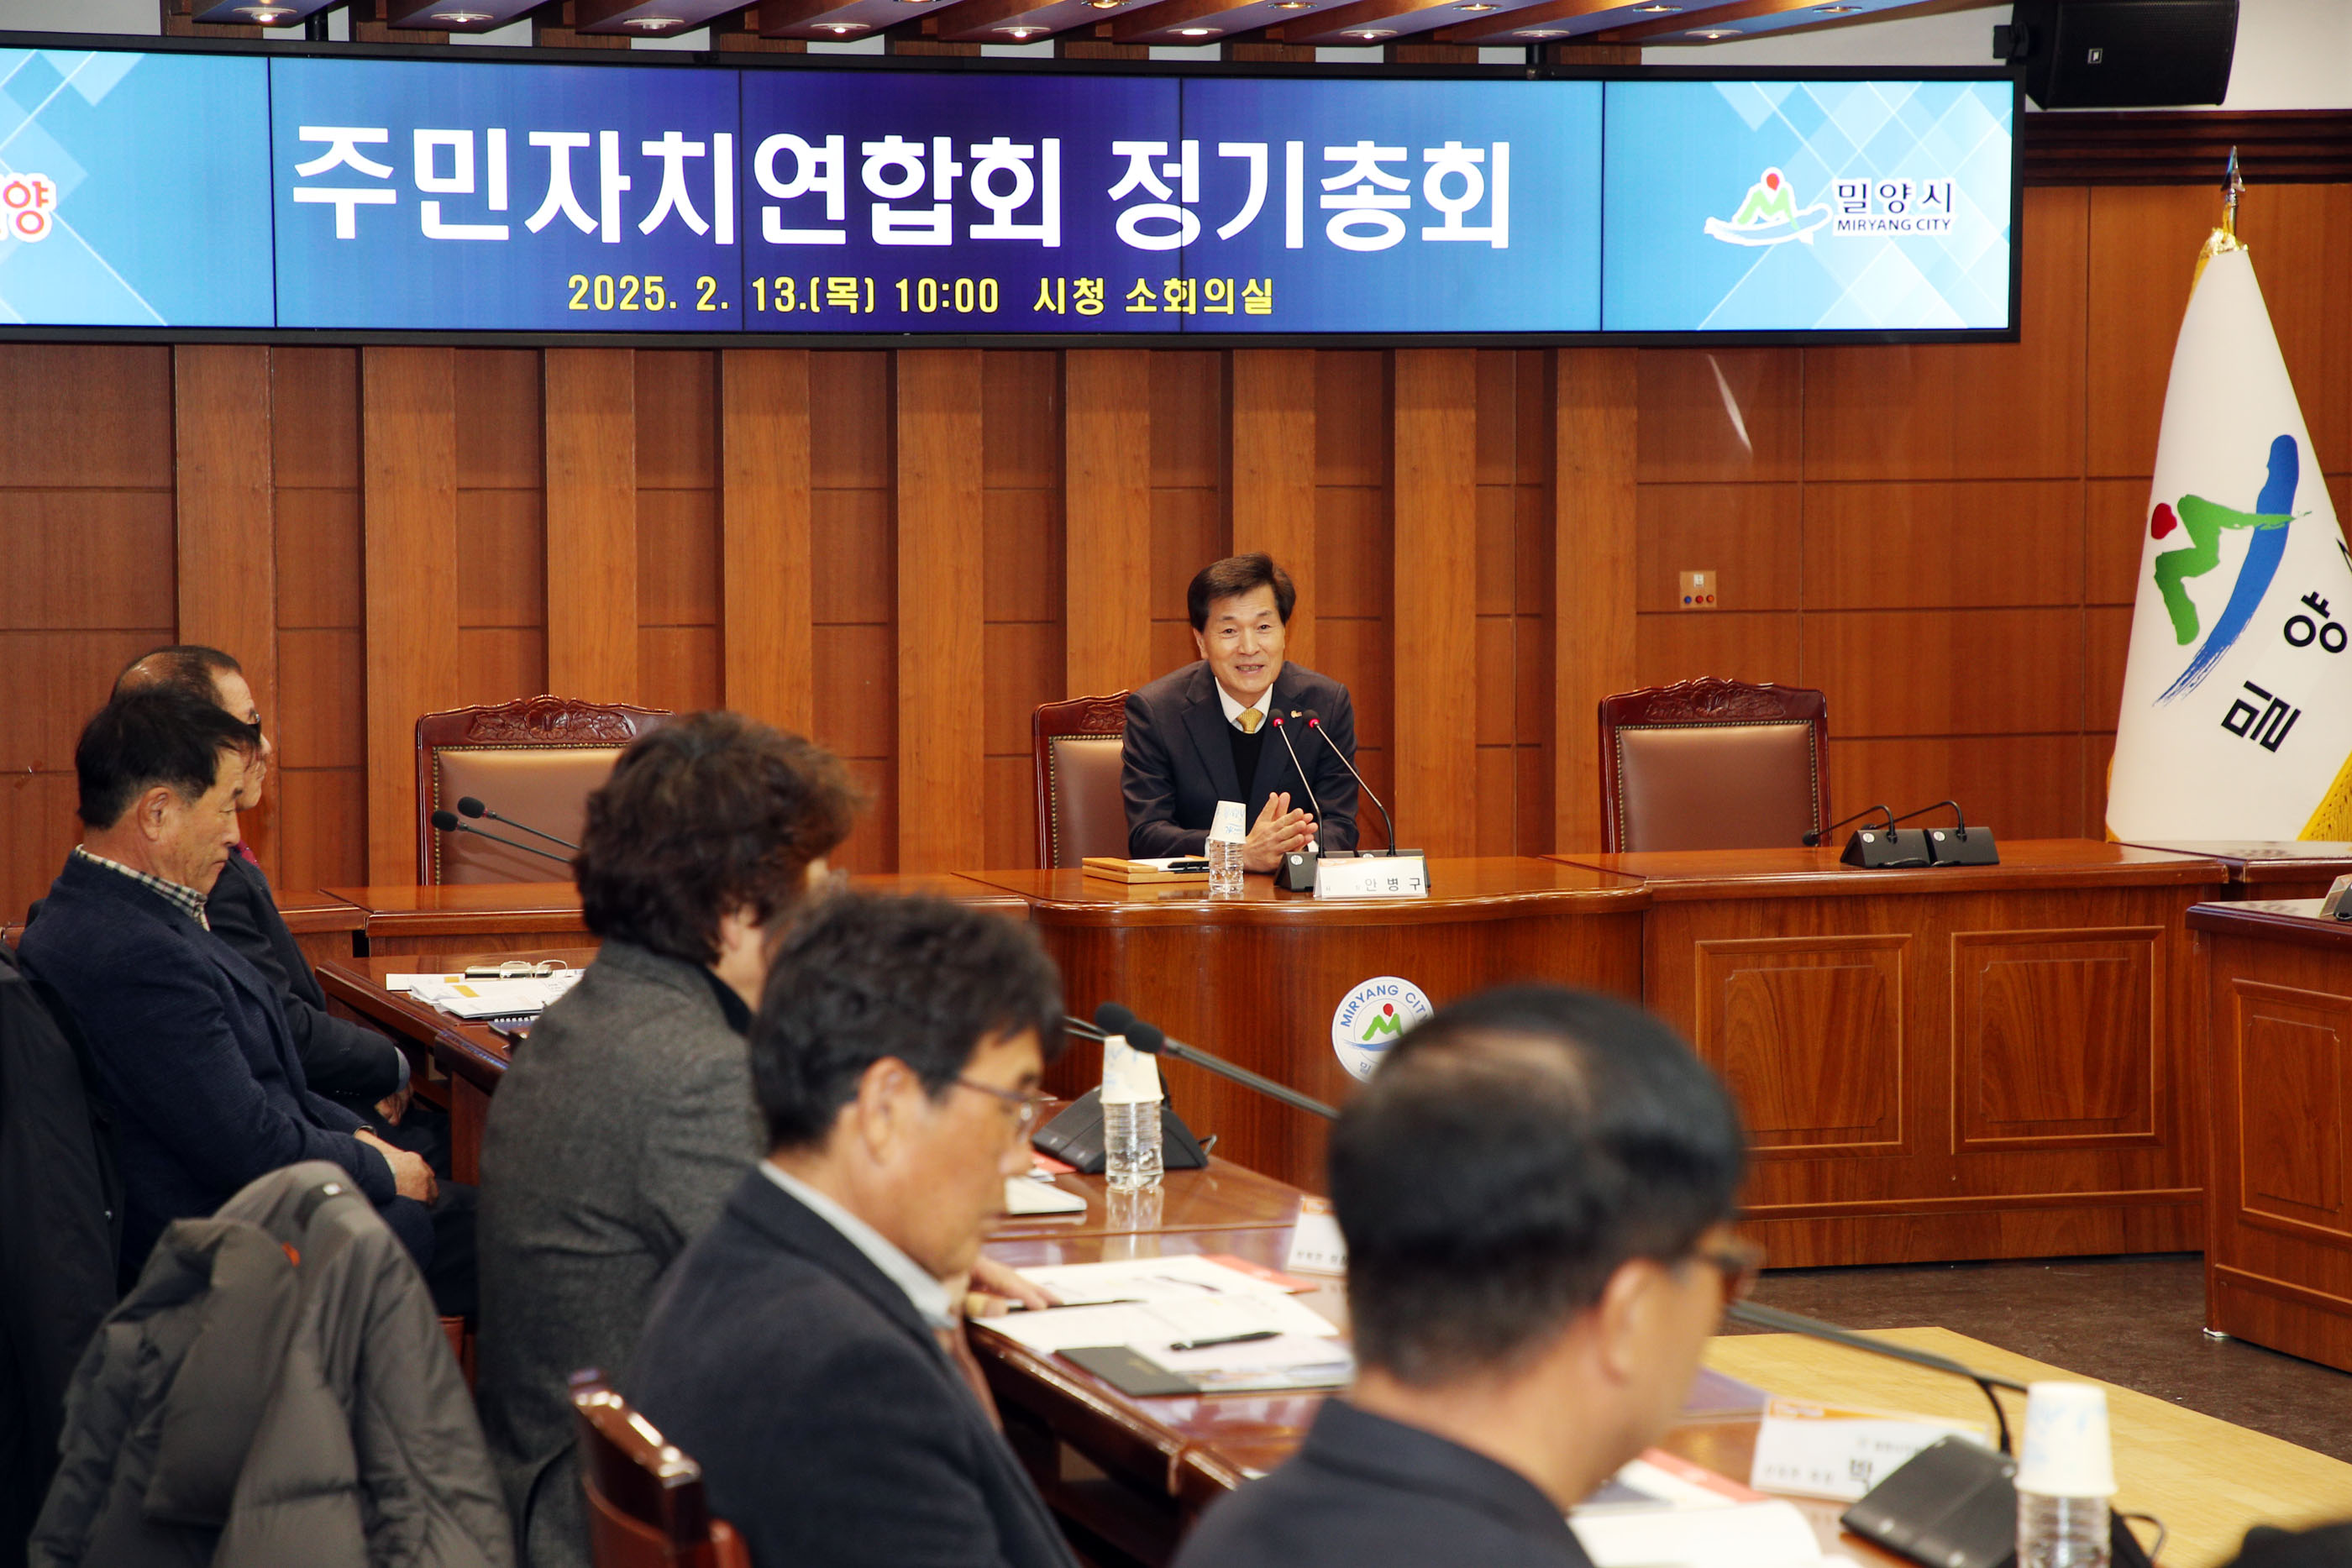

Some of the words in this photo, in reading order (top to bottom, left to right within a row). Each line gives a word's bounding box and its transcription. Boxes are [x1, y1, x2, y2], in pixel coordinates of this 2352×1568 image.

[0, 180, 49, 235] 양
[293, 125, 1061, 248] 주민자치연합회
[1107, 139, 1511, 252] 정기총회
[1837, 182, 1950, 214] 밀양시
[1837, 218, 1911, 231] MIRYANG
[1916, 218, 1950, 231] CITY
[567, 274, 677, 312] 2025.
[696, 275, 729, 312] 2.
[752, 276, 874, 314] 13.(목)
[895, 277, 999, 314] 10:00
[1033, 277, 1105, 316] 시청
[1125, 277, 1273, 315] 소회의실
[1365, 877, 1420, 892] 안병구
[1341, 985, 1399, 1027] MIRYANG
